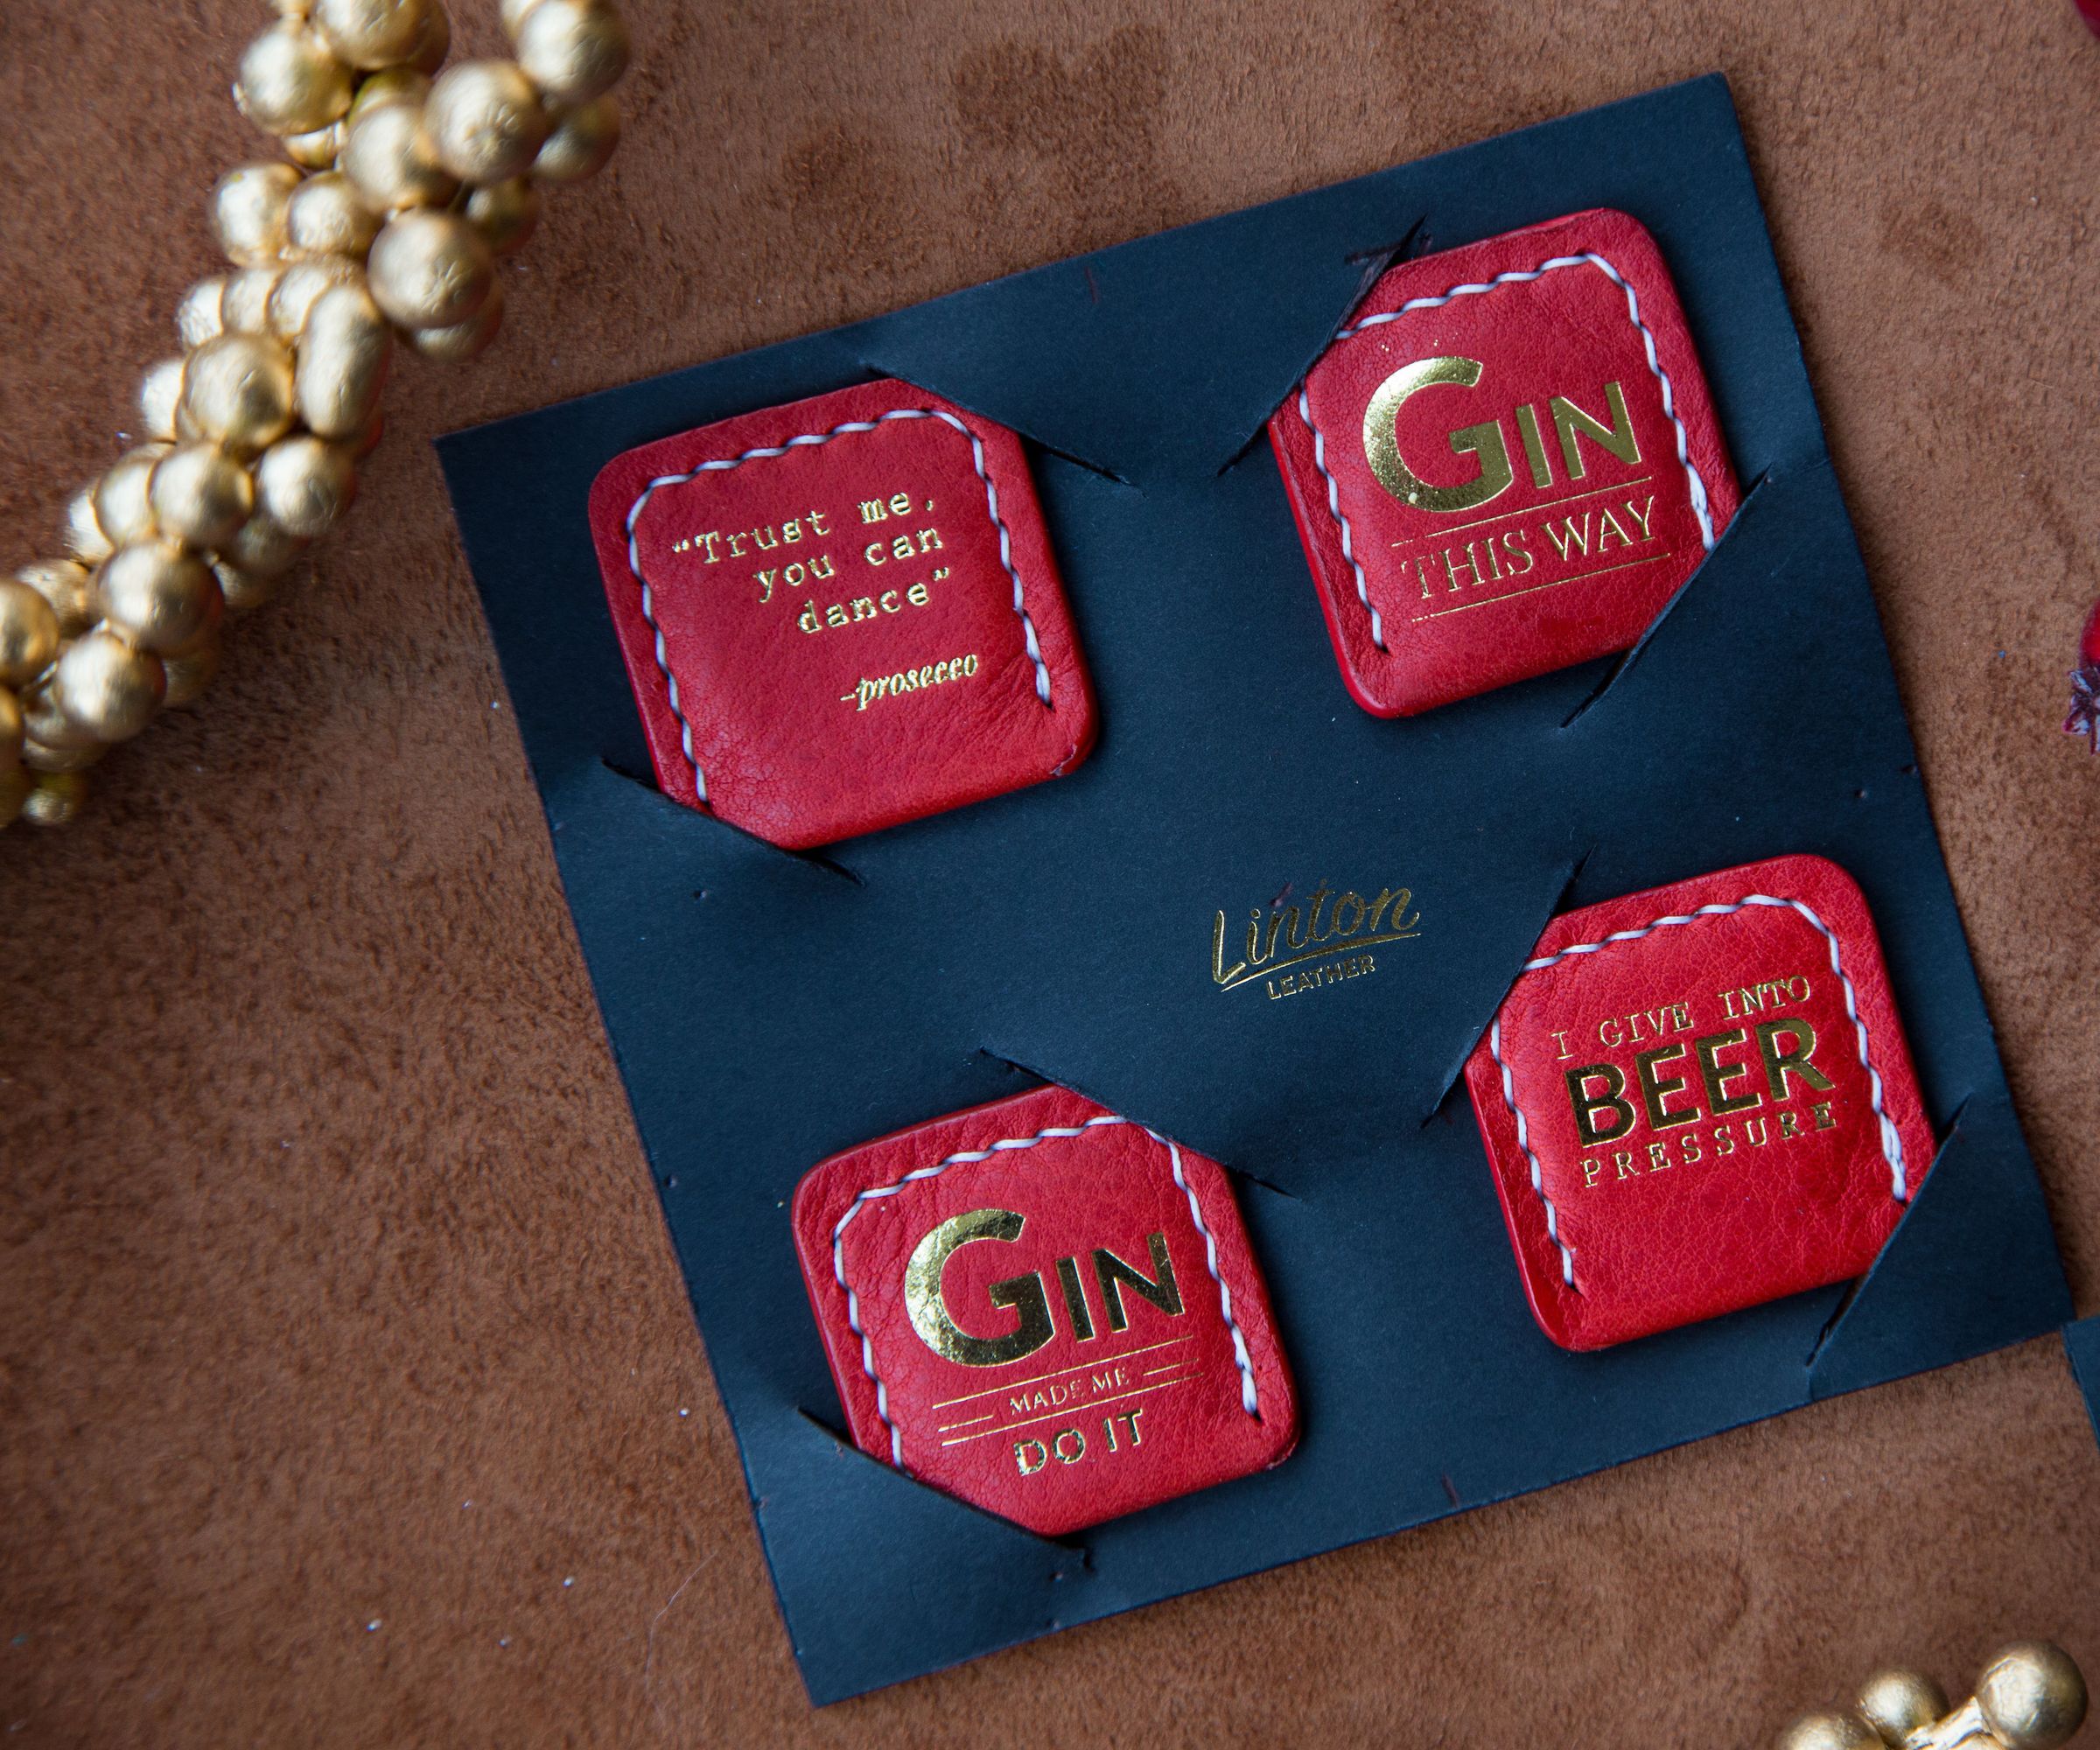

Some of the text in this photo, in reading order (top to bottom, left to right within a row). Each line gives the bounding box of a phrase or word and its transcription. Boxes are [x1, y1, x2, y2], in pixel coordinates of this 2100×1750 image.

[753, 526, 942, 603] you can
[1401, 494, 1656, 599] THIS WAY
[1213, 878, 1420, 984] Linton
[1266, 954, 1376, 1000] LEATHER
[1550, 976, 1810, 1060] I GIVE INTO
[1564, 1017, 1837, 1149] BEER
[1579, 1101, 1837, 1188] PRESSURE
[1009, 1367, 1130, 1417] MADE ME
[1014, 1408, 1143, 1477] DO IT
